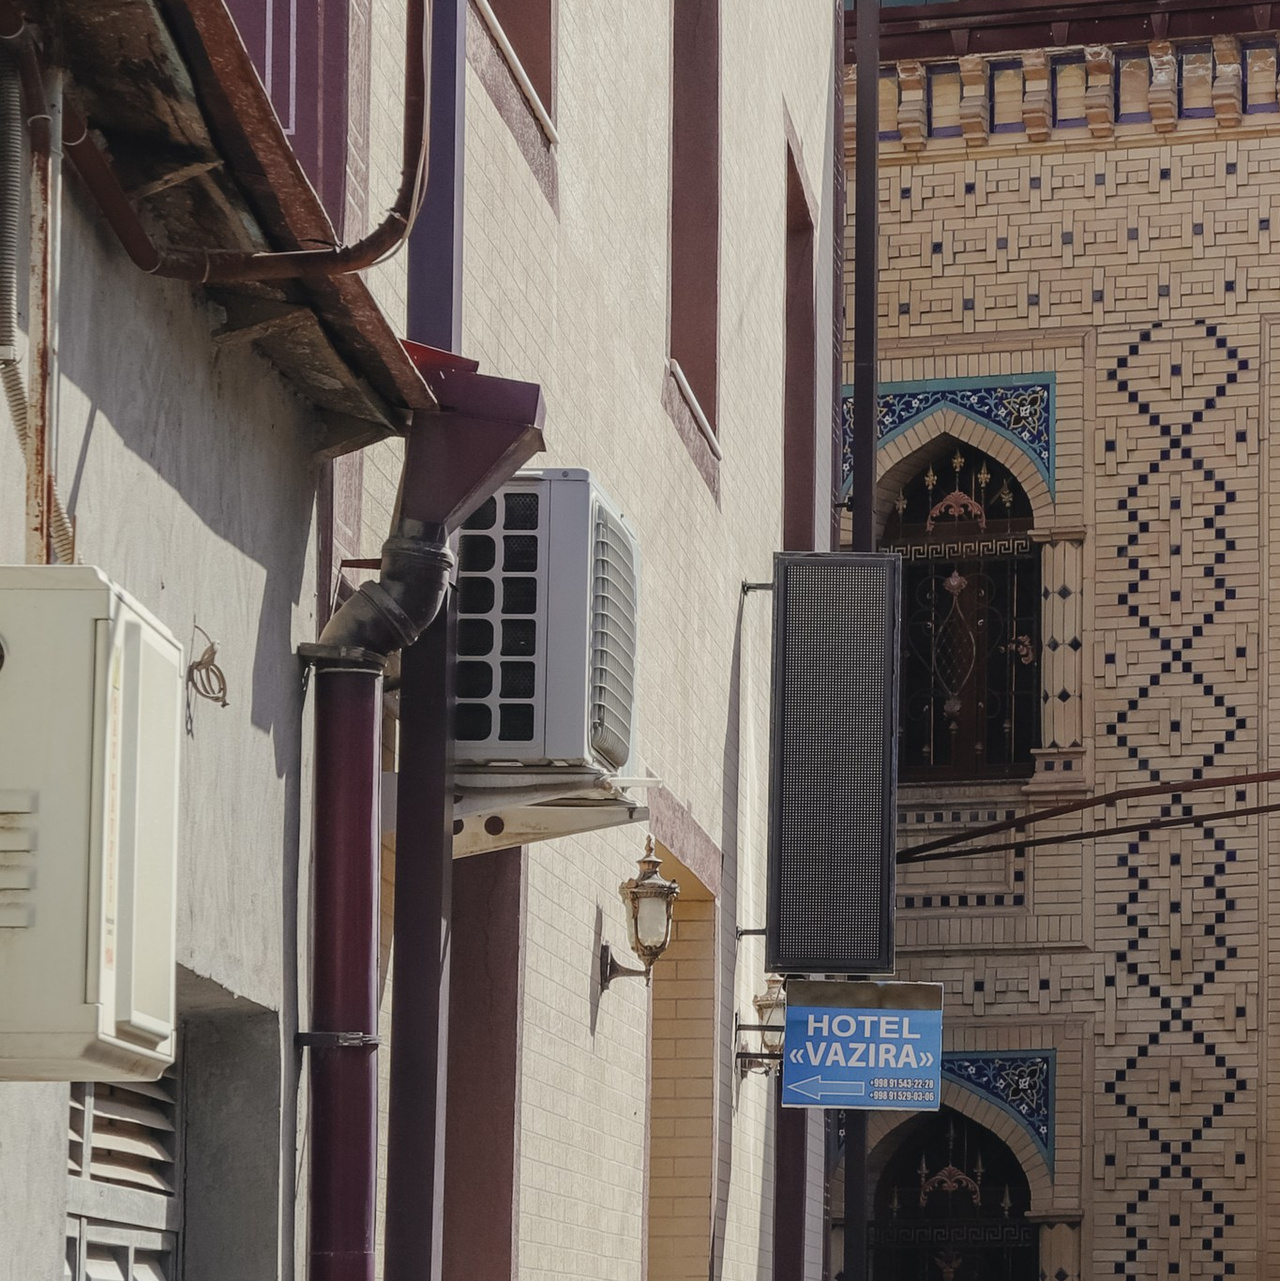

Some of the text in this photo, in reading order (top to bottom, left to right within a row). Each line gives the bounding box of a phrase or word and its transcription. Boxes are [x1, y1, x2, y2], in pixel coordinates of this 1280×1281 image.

[807, 1014, 921, 1039] HOTEL
[789, 1041, 934, 1069] «VAZIRA»
[869, 1078, 888, 1088] +998
[889, 1078, 897, 1088] 91
[869, 1090, 888, 1100] +998
[889, 1091, 897, 1100] 91
